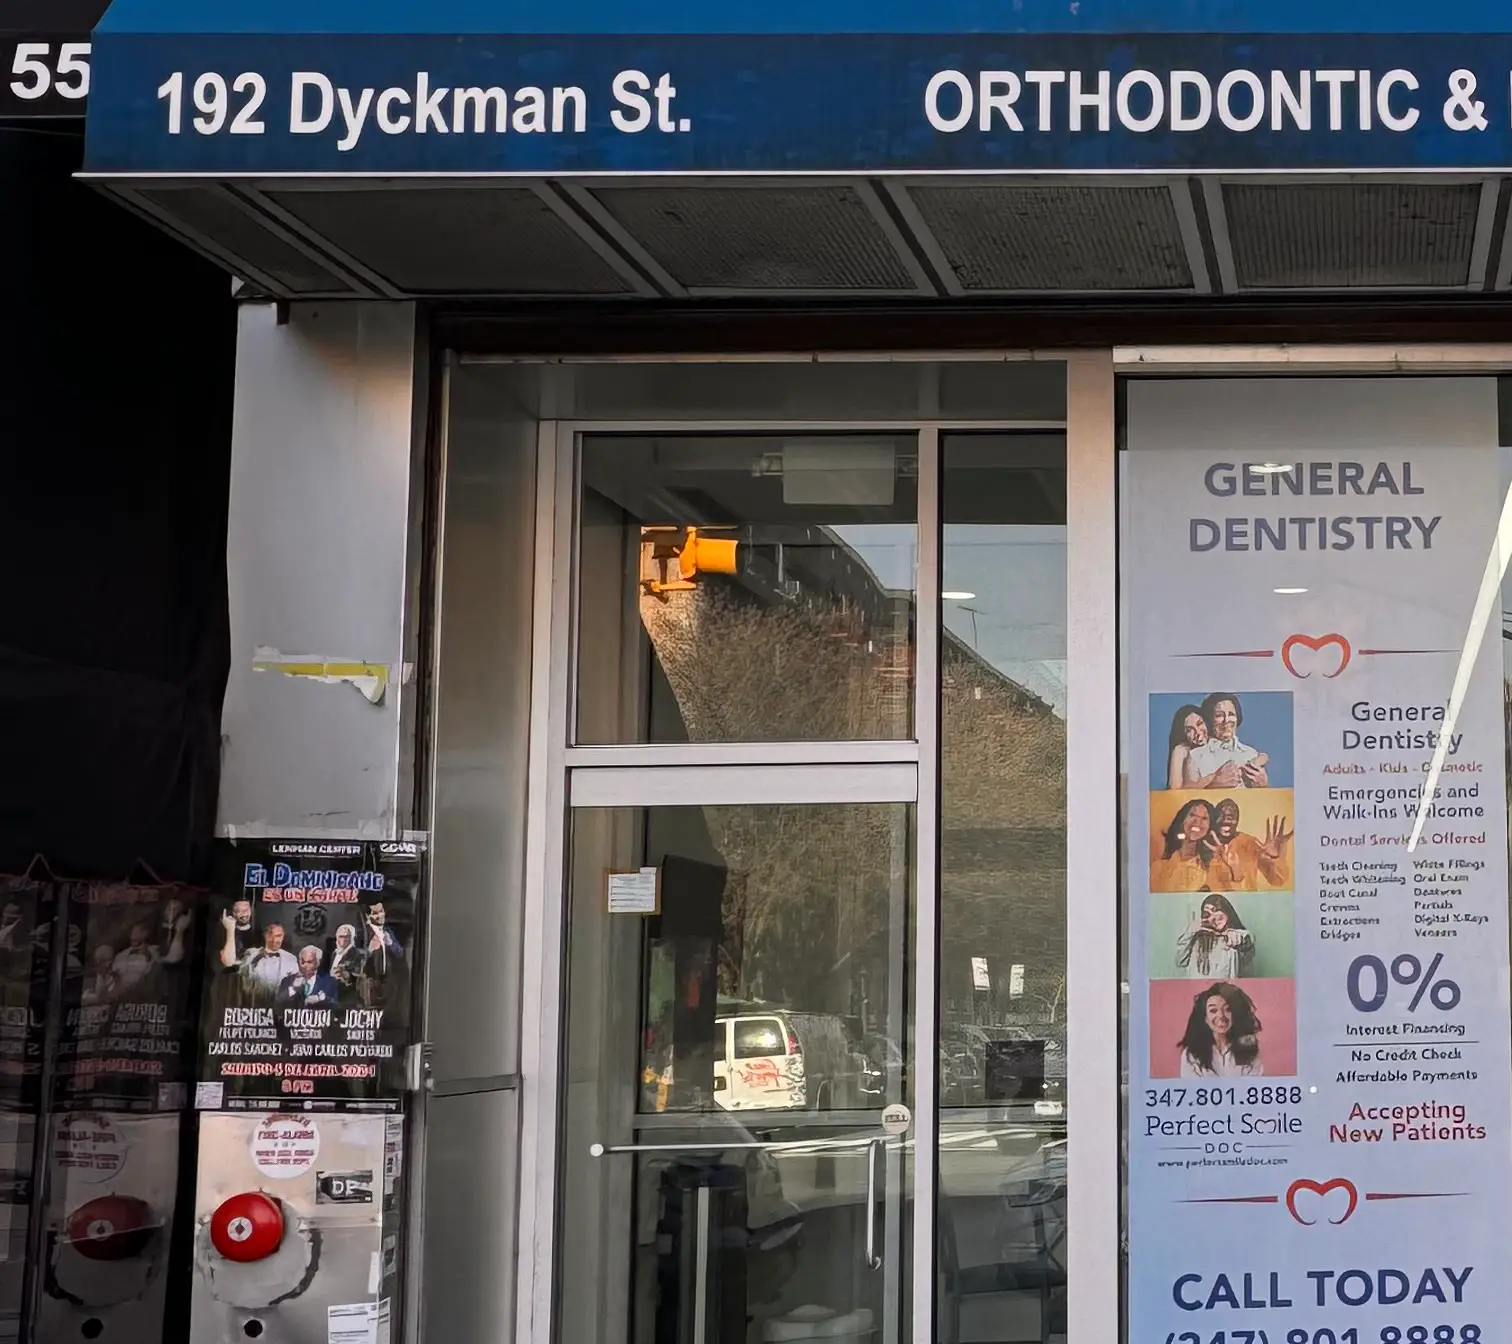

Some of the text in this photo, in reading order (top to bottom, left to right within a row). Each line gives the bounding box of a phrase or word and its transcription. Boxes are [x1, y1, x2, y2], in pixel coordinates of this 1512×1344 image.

[10, 41, 91, 100] 55
[157, 69, 693, 152] 192 Dyckman St.
[924, 68, 1420, 133] ORTHODONTIC
[1442, 68, 1489, 132] &
[1203, 461, 1425, 498] GENERAL
[1188, 515, 1442, 553] DENTISTRY
[1342, 728, 1463, 755] Dentisty
[1328, 783, 1480, 803] Emergencis and
[1323, 804, 1485, 820] Walk-Ins Wlcome
[1432, 831, 1486, 845] Offered
[1346, 952, 1462, 1013] 0%
[1351, 1050, 1372, 1062] No
[1375, 1049, 1418, 1061] Credit
[1335, 1070, 1479, 1084] Affordable Payments
[1145, 1086, 1302, 1108] 347.801.8888
[1348, 1101, 1466, 1124] Accepting
[1144, 1115, 1234, 1137] Perfect
[1329, 1123, 1487, 1143] New Patients
[1204, 1142, 1244, 1154] DOC
[1172, 1267, 1474, 1312] CALL TODAY
